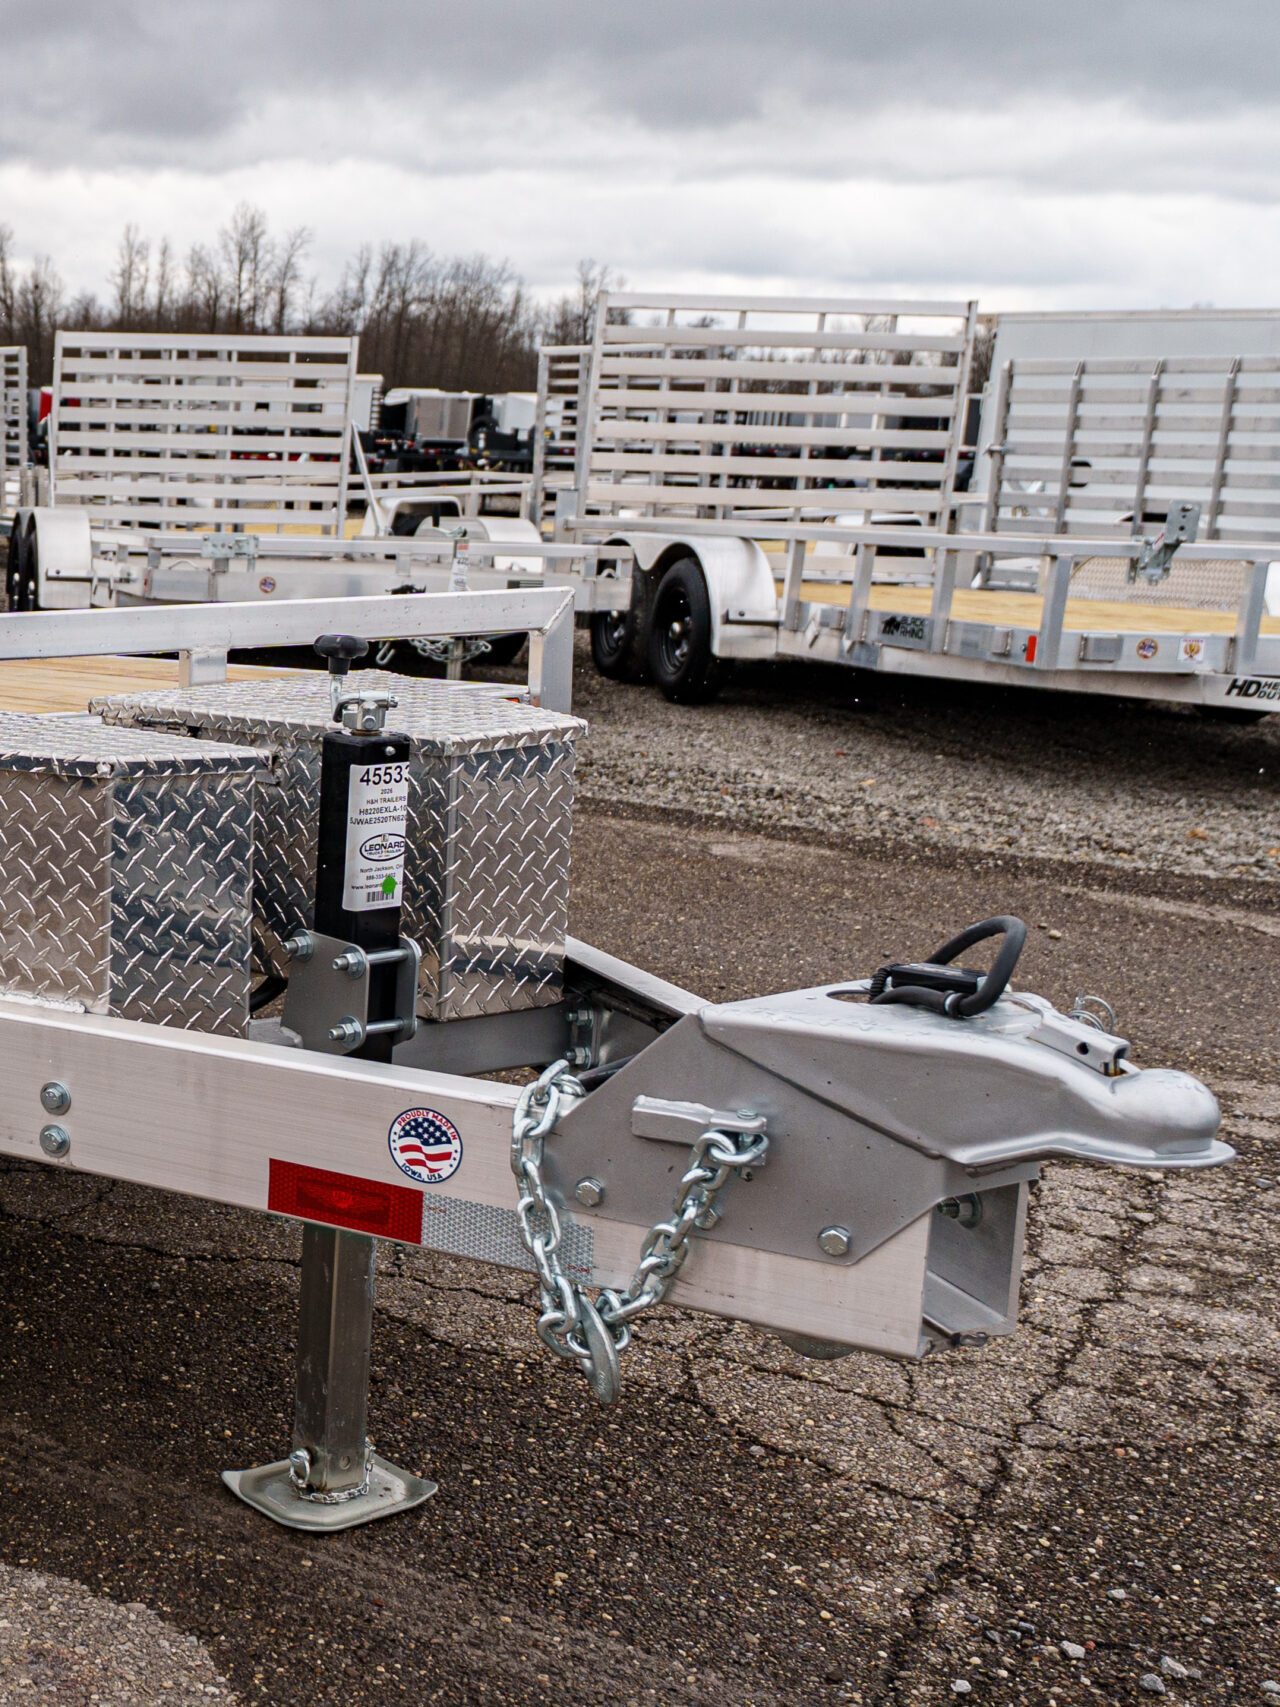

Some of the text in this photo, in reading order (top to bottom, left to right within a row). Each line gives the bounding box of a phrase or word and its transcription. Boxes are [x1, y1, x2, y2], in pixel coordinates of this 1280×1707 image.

[1225, 678, 1261, 698] HD
[364, 840, 405, 852] LEONARD
[396, 1110, 458, 1141] PROUDLY MADE IN
[426, 1172, 444, 1181] USA
